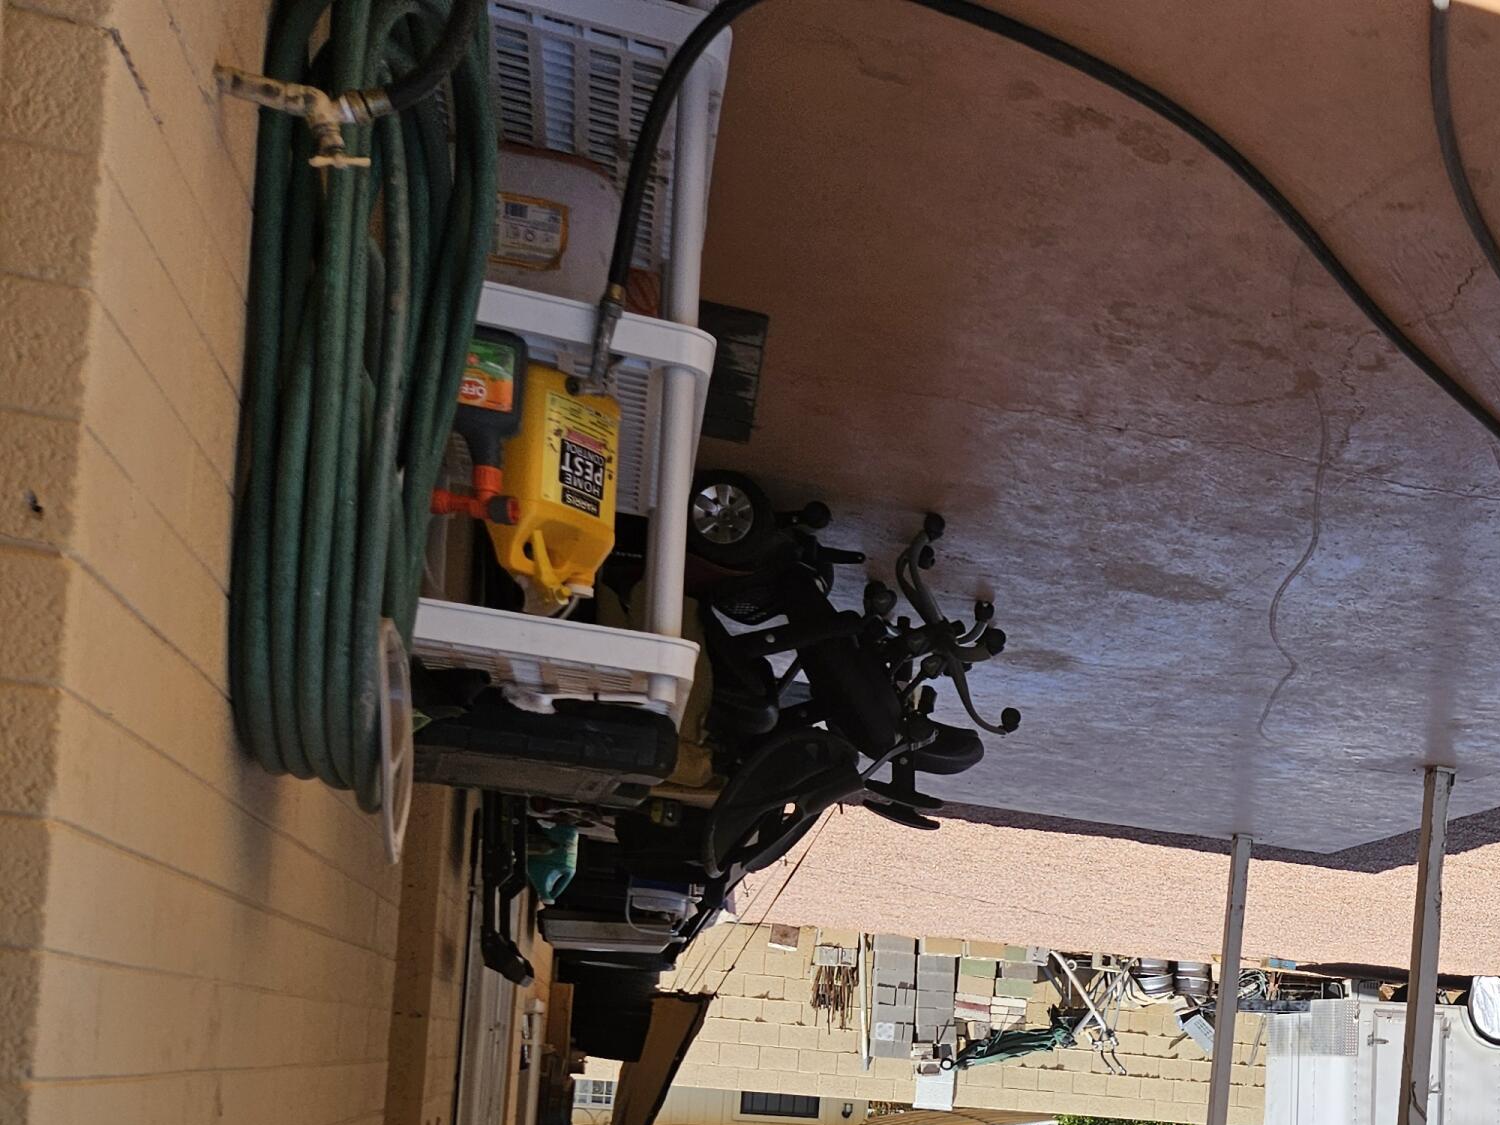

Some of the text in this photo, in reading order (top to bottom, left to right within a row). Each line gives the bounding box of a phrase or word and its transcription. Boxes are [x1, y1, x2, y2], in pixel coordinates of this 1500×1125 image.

[564, 441, 604, 466] CONTROL
[561, 452, 603, 486] PEST
[564, 473, 600, 497] HOME
[565, 493, 598, 515] HARRIS
